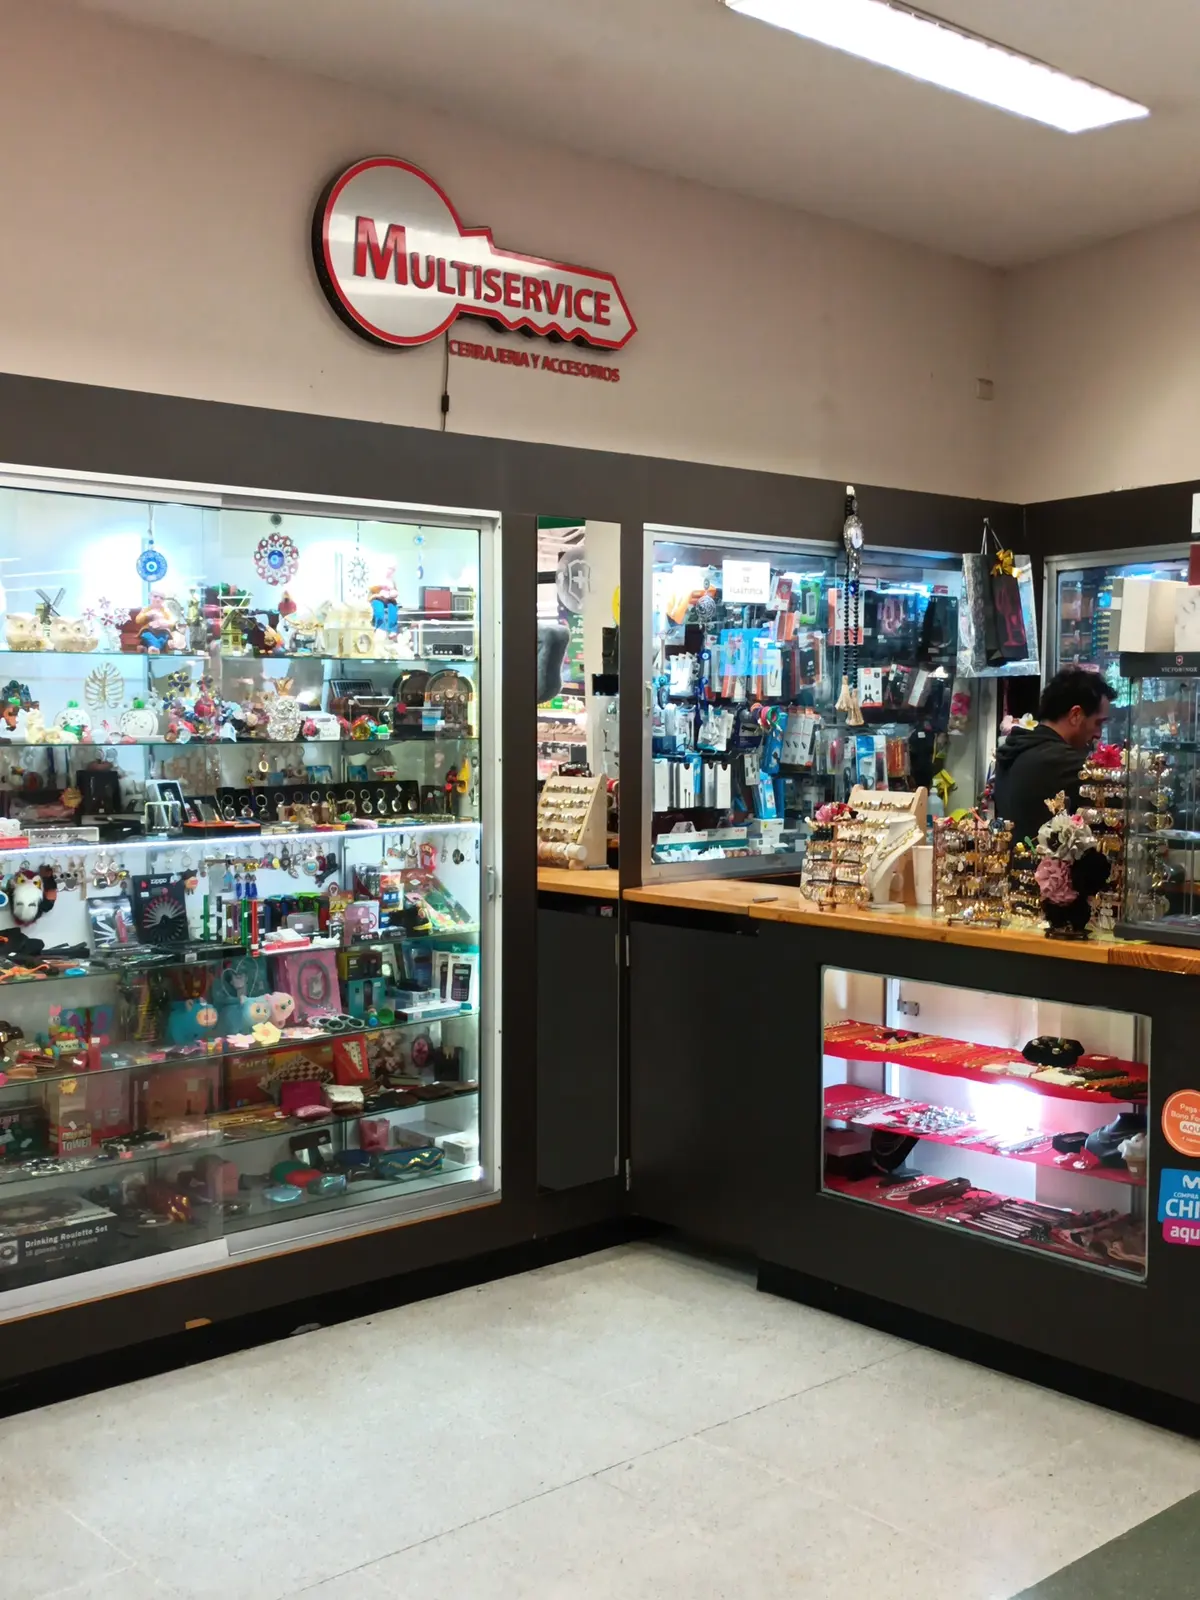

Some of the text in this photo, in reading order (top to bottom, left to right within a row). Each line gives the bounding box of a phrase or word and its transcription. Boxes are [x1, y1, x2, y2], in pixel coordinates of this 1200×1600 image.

[530, 353, 541, 370] Y
[541, 355, 621, 383] ACCESORIOS
[25, 1236, 59, 1248] Drinking
[60, 1229, 93, 1241] Roulette
[95, 1225, 108, 1233] Set
